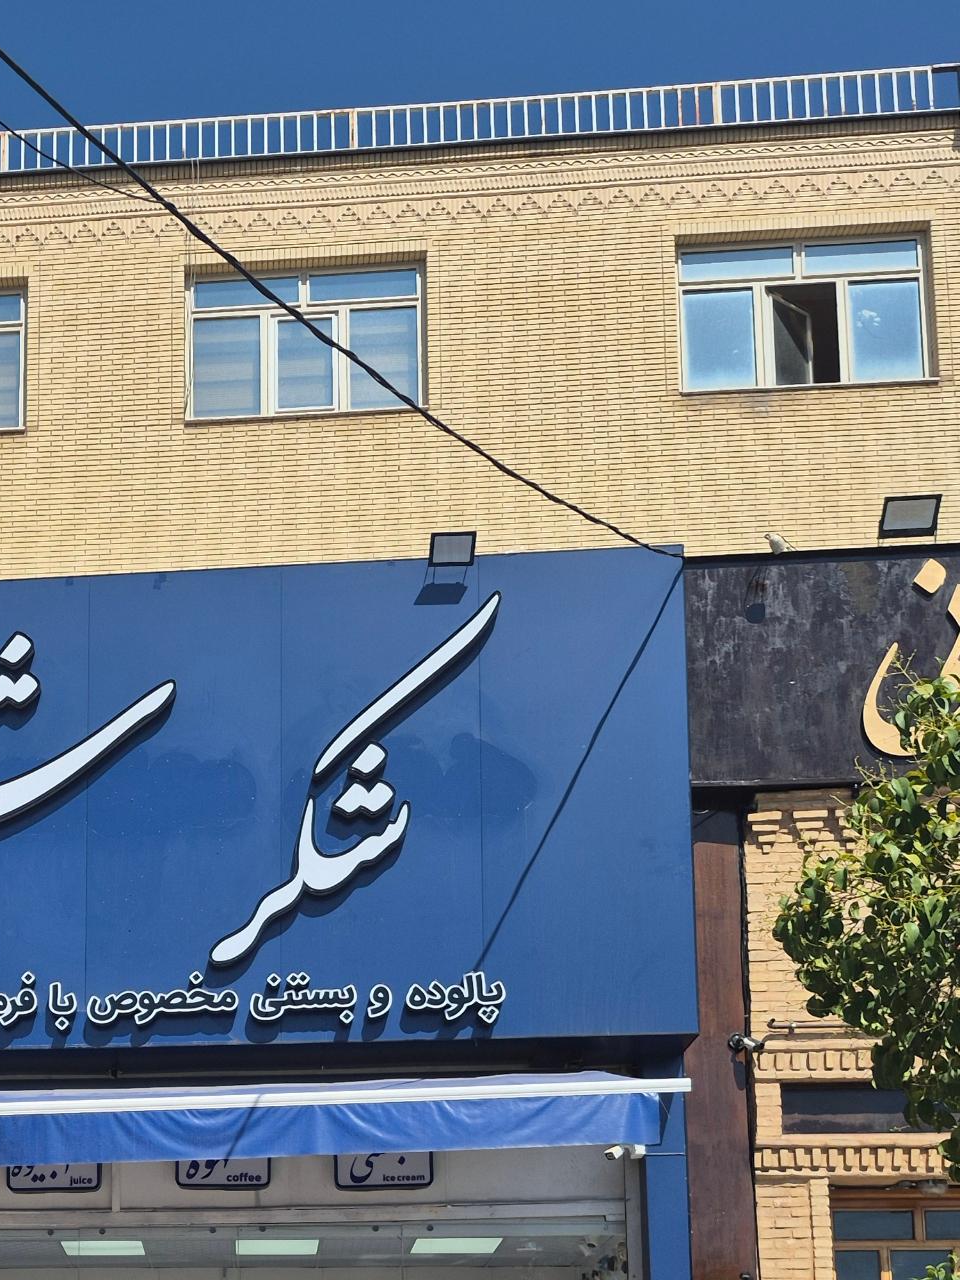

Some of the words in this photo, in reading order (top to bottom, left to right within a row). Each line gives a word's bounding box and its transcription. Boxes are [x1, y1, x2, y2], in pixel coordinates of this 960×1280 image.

[209, 590, 503, 966] شکر
[48, 981, 78, 1030] با
[86, 971, 239, 1025] مخصوص
[249, 972, 357, 1024] بستنی
[367, 984, 393, 1018] و
[405, 971, 506, 1023] پالوده
[69, 1176, 93, 1186] juice
[226, 1172, 262, 1182] coffee
[383, 1174, 396, 1182] ice
[397, 1174, 426, 1182] cream
